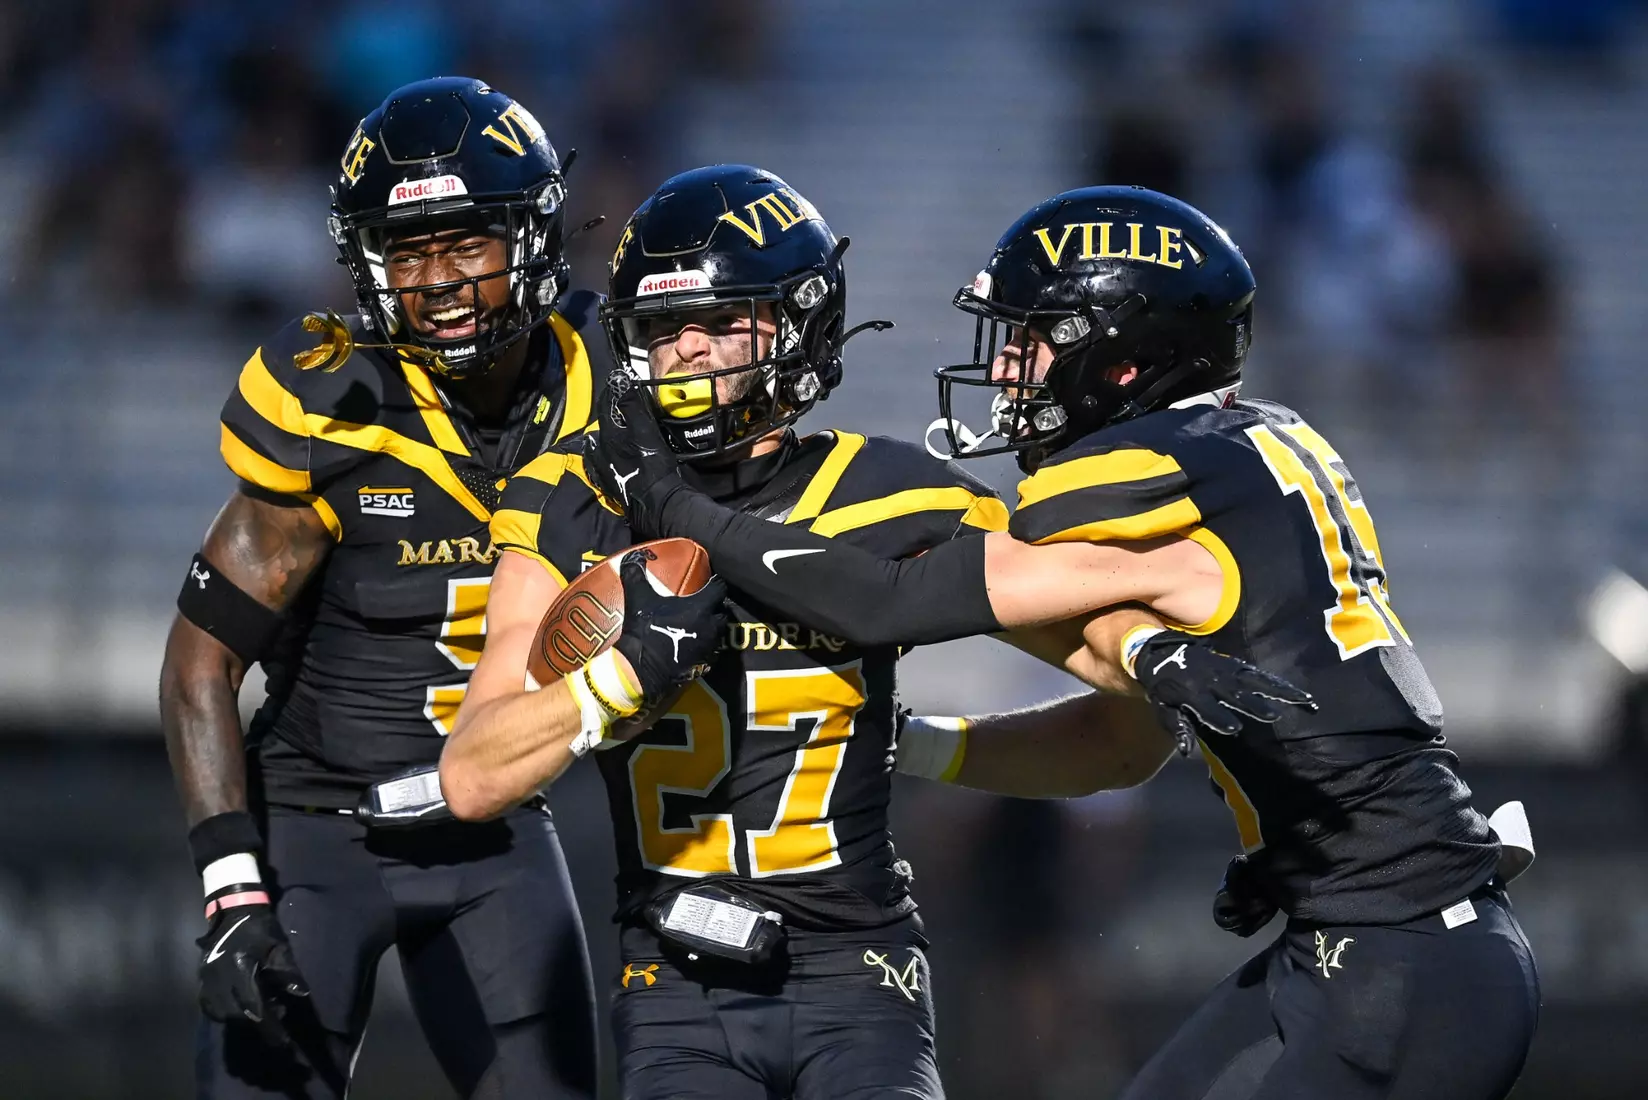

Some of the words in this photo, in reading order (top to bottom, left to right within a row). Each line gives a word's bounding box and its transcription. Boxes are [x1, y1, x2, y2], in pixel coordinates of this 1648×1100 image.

[1033, 222, 1184, 270] VILLE
[444, 344, 477, 358] Riddell
[684, 425, 715, 439] Riddell
[358, 494, 415, 509] PSAC
[627, 658, 869, 878] 27
